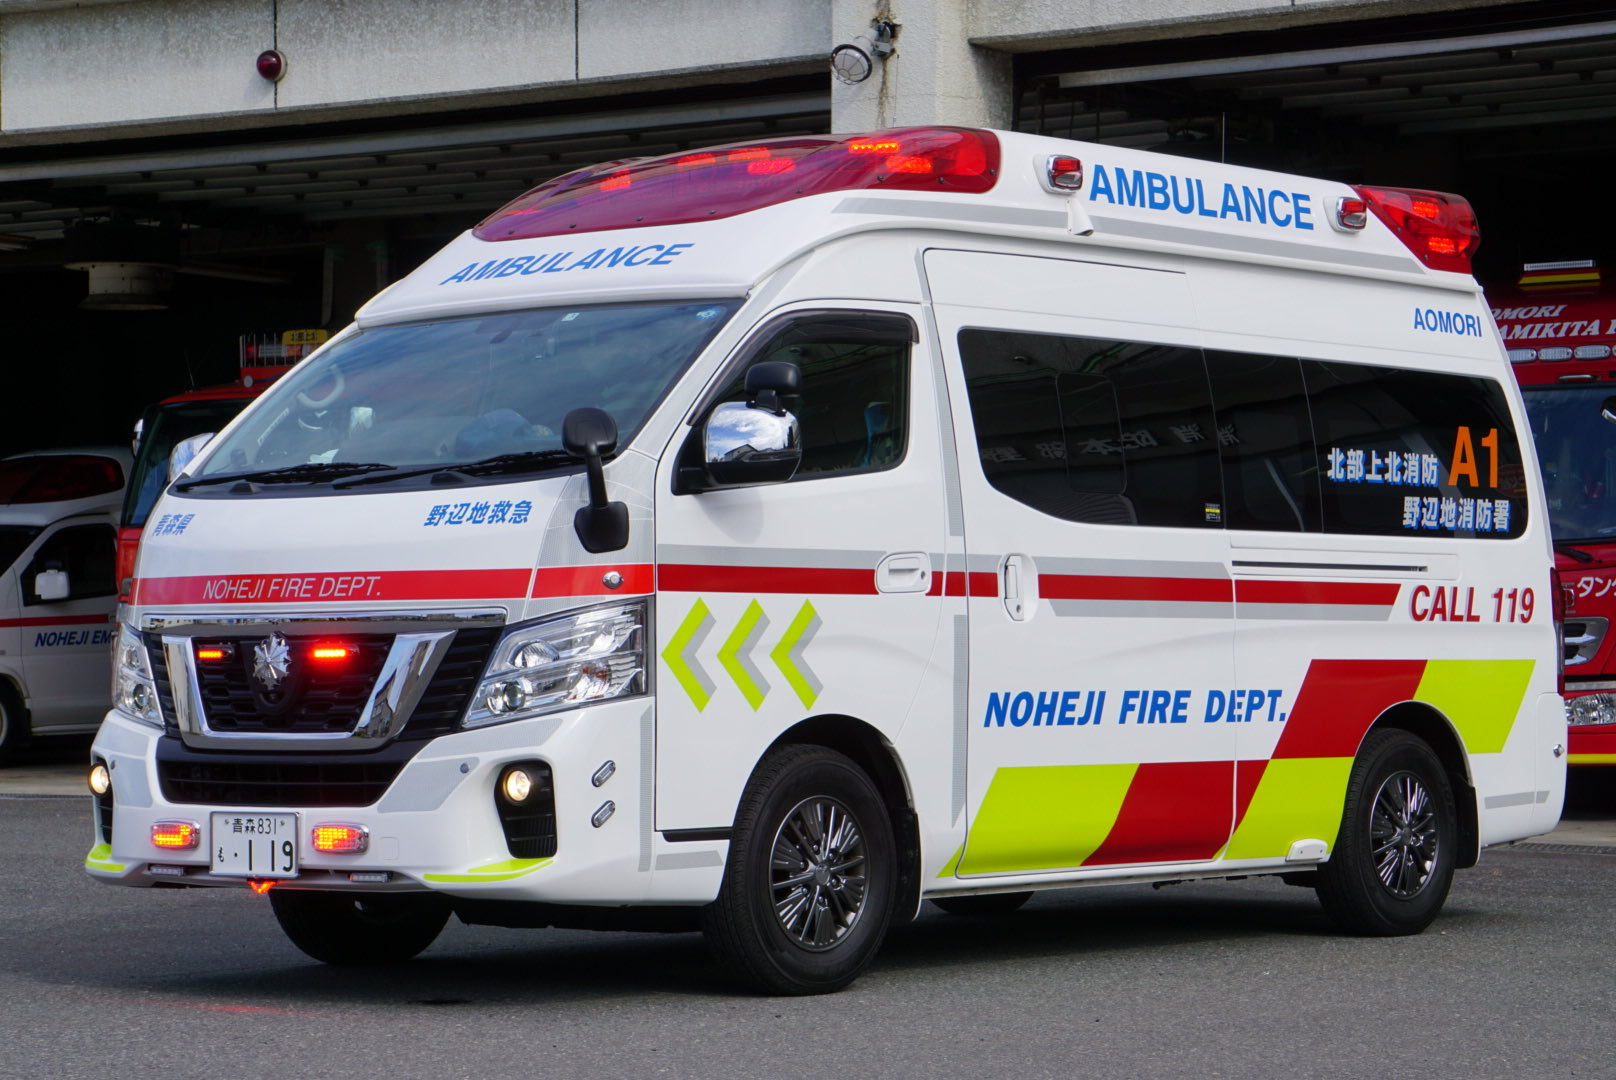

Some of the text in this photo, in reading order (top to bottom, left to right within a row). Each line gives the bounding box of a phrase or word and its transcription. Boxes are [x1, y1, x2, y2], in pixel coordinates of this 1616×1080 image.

[1089, 164, 1314, 231] AMBULANCE
[438, 243, 695, 286] AMBULANCE
[1413, 307, 1482, 338] AOMORI
[1327, 447, 1439, 487] 北部上北消防
[1448, 426, 1498, 488] A1
[153, 514, 195, 536] 青森県
[424, 500, 532, 526] 野辺地救急
[1402, 496, 1511, 532] 野辺地消防署
[203, 576, 381, 599] NOHEJI FIRE DEPT.
[1411, 585, 1535, 623] CALL 119
[1577, 576, 1616, 597] タン
[35, 631, 89, 647] NOHEJI
[983, 689, 1287, 728] NOHEJI FIRE DEPT.
